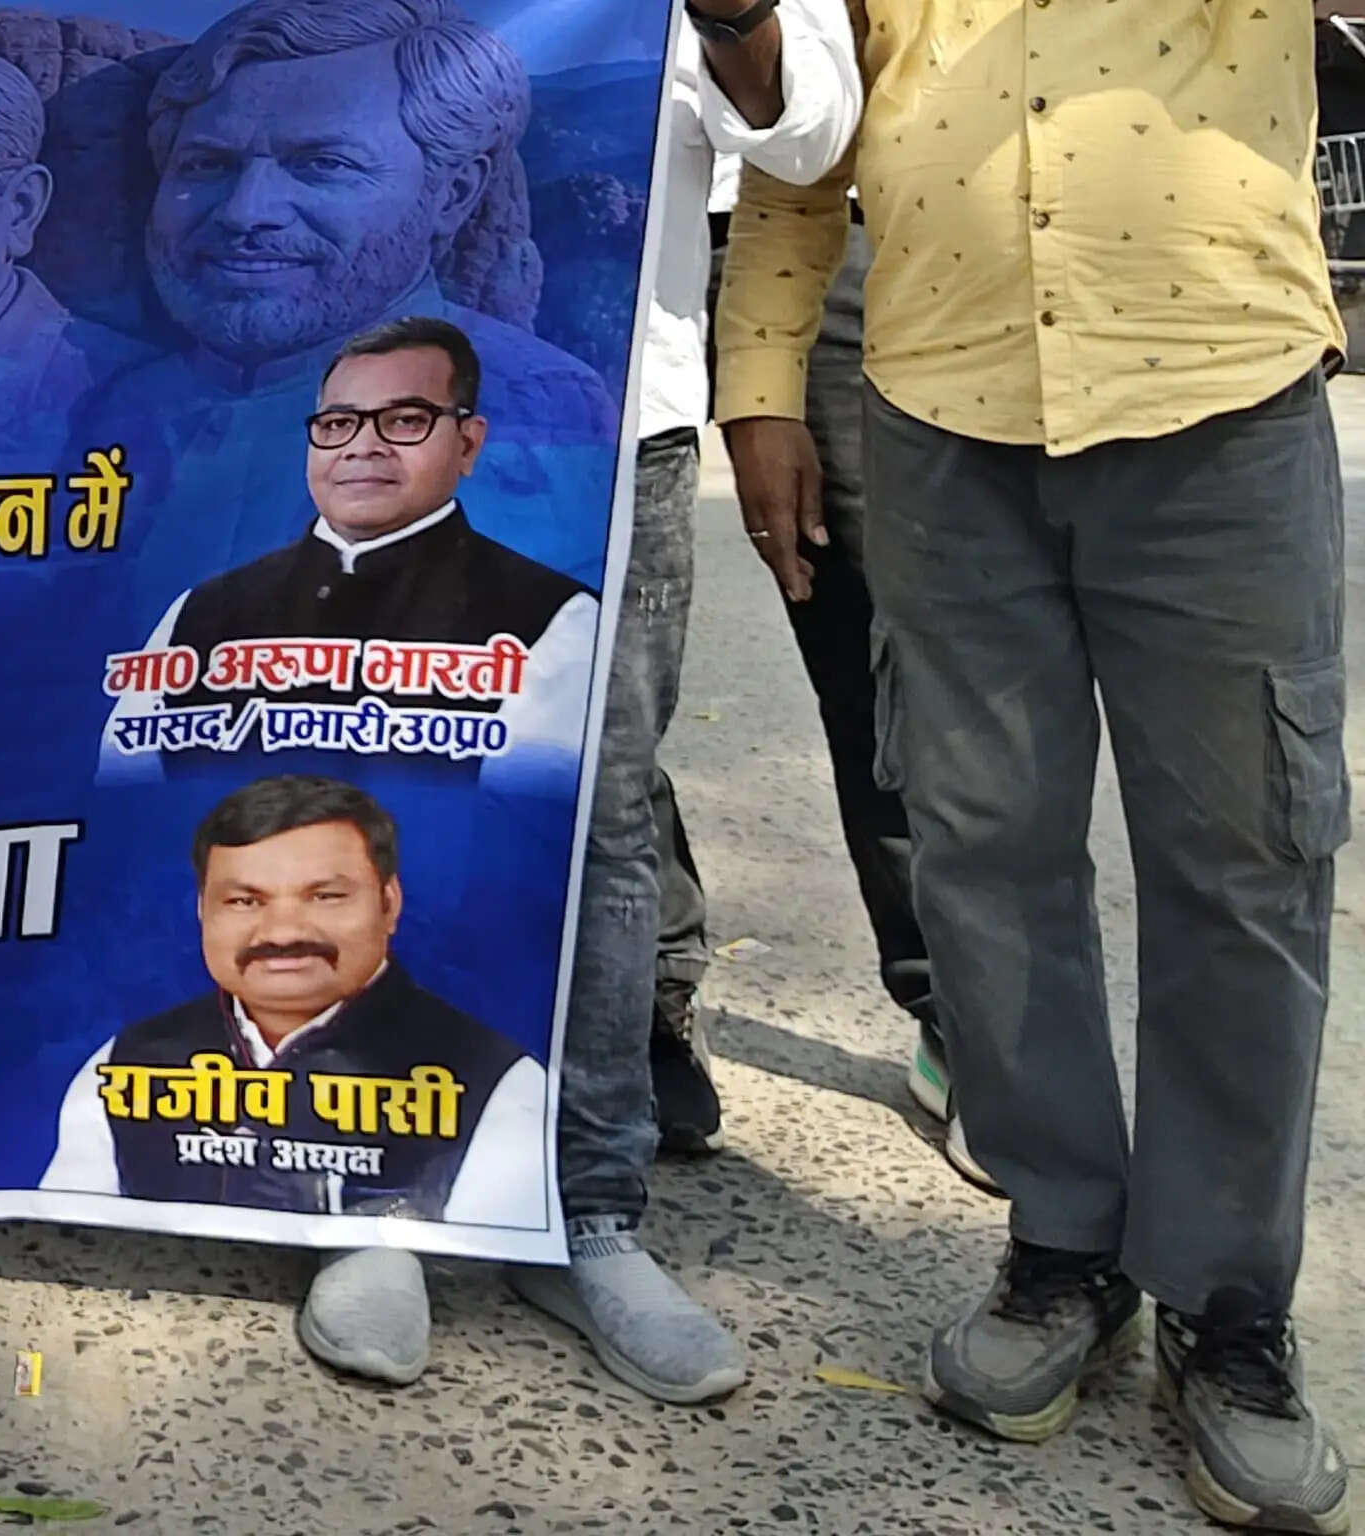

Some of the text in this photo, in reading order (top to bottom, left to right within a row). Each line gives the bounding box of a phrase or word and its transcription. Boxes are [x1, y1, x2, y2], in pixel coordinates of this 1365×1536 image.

[64, 449, 131, 553] में
[365, 634, 529, 695] भारती
[98, 1054, 465, 1139] राजीव पासी
[176, 1128, 259, 1167] प्रदेश
